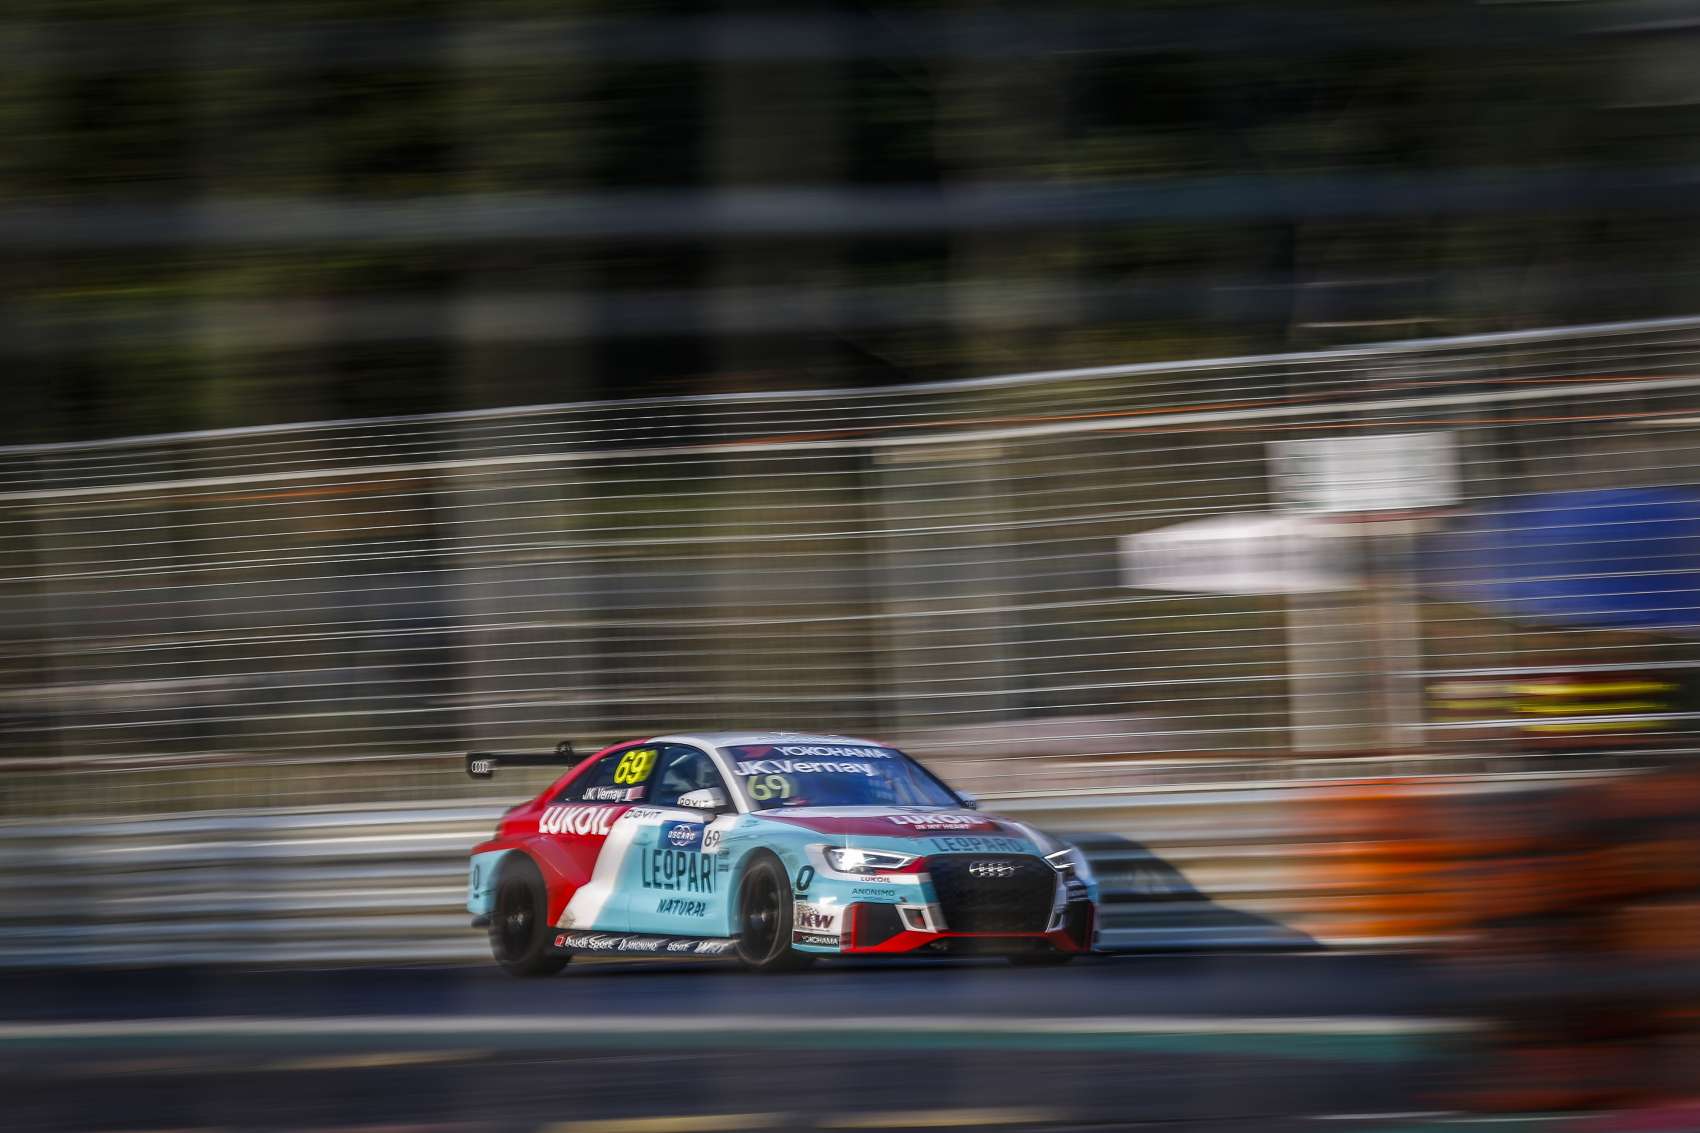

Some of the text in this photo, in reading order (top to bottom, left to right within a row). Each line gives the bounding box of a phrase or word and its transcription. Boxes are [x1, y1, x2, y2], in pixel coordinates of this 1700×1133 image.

[774, 746, 892, 759] YOKOHAMA
[614, 751, 651, 785] 69
[597, 787, 622, 803] Vernay
[748, 774, 791, 801] 69
[539, 805, 613, 835] LUKOIL
[887, 815, 984, 825] LUKOIL
[704, 830, 720, 848] 69
[931, 838, 1023, 852] LEOPARD
[852, 888, 896, 897] ANONIMO
[656, 899, 706, 917] NATURAL
[800, 914, 834, 928] KW
[565, 937, 613, 952] Audi Sport
[801, 935, 839, 944] YOKOHAMA
